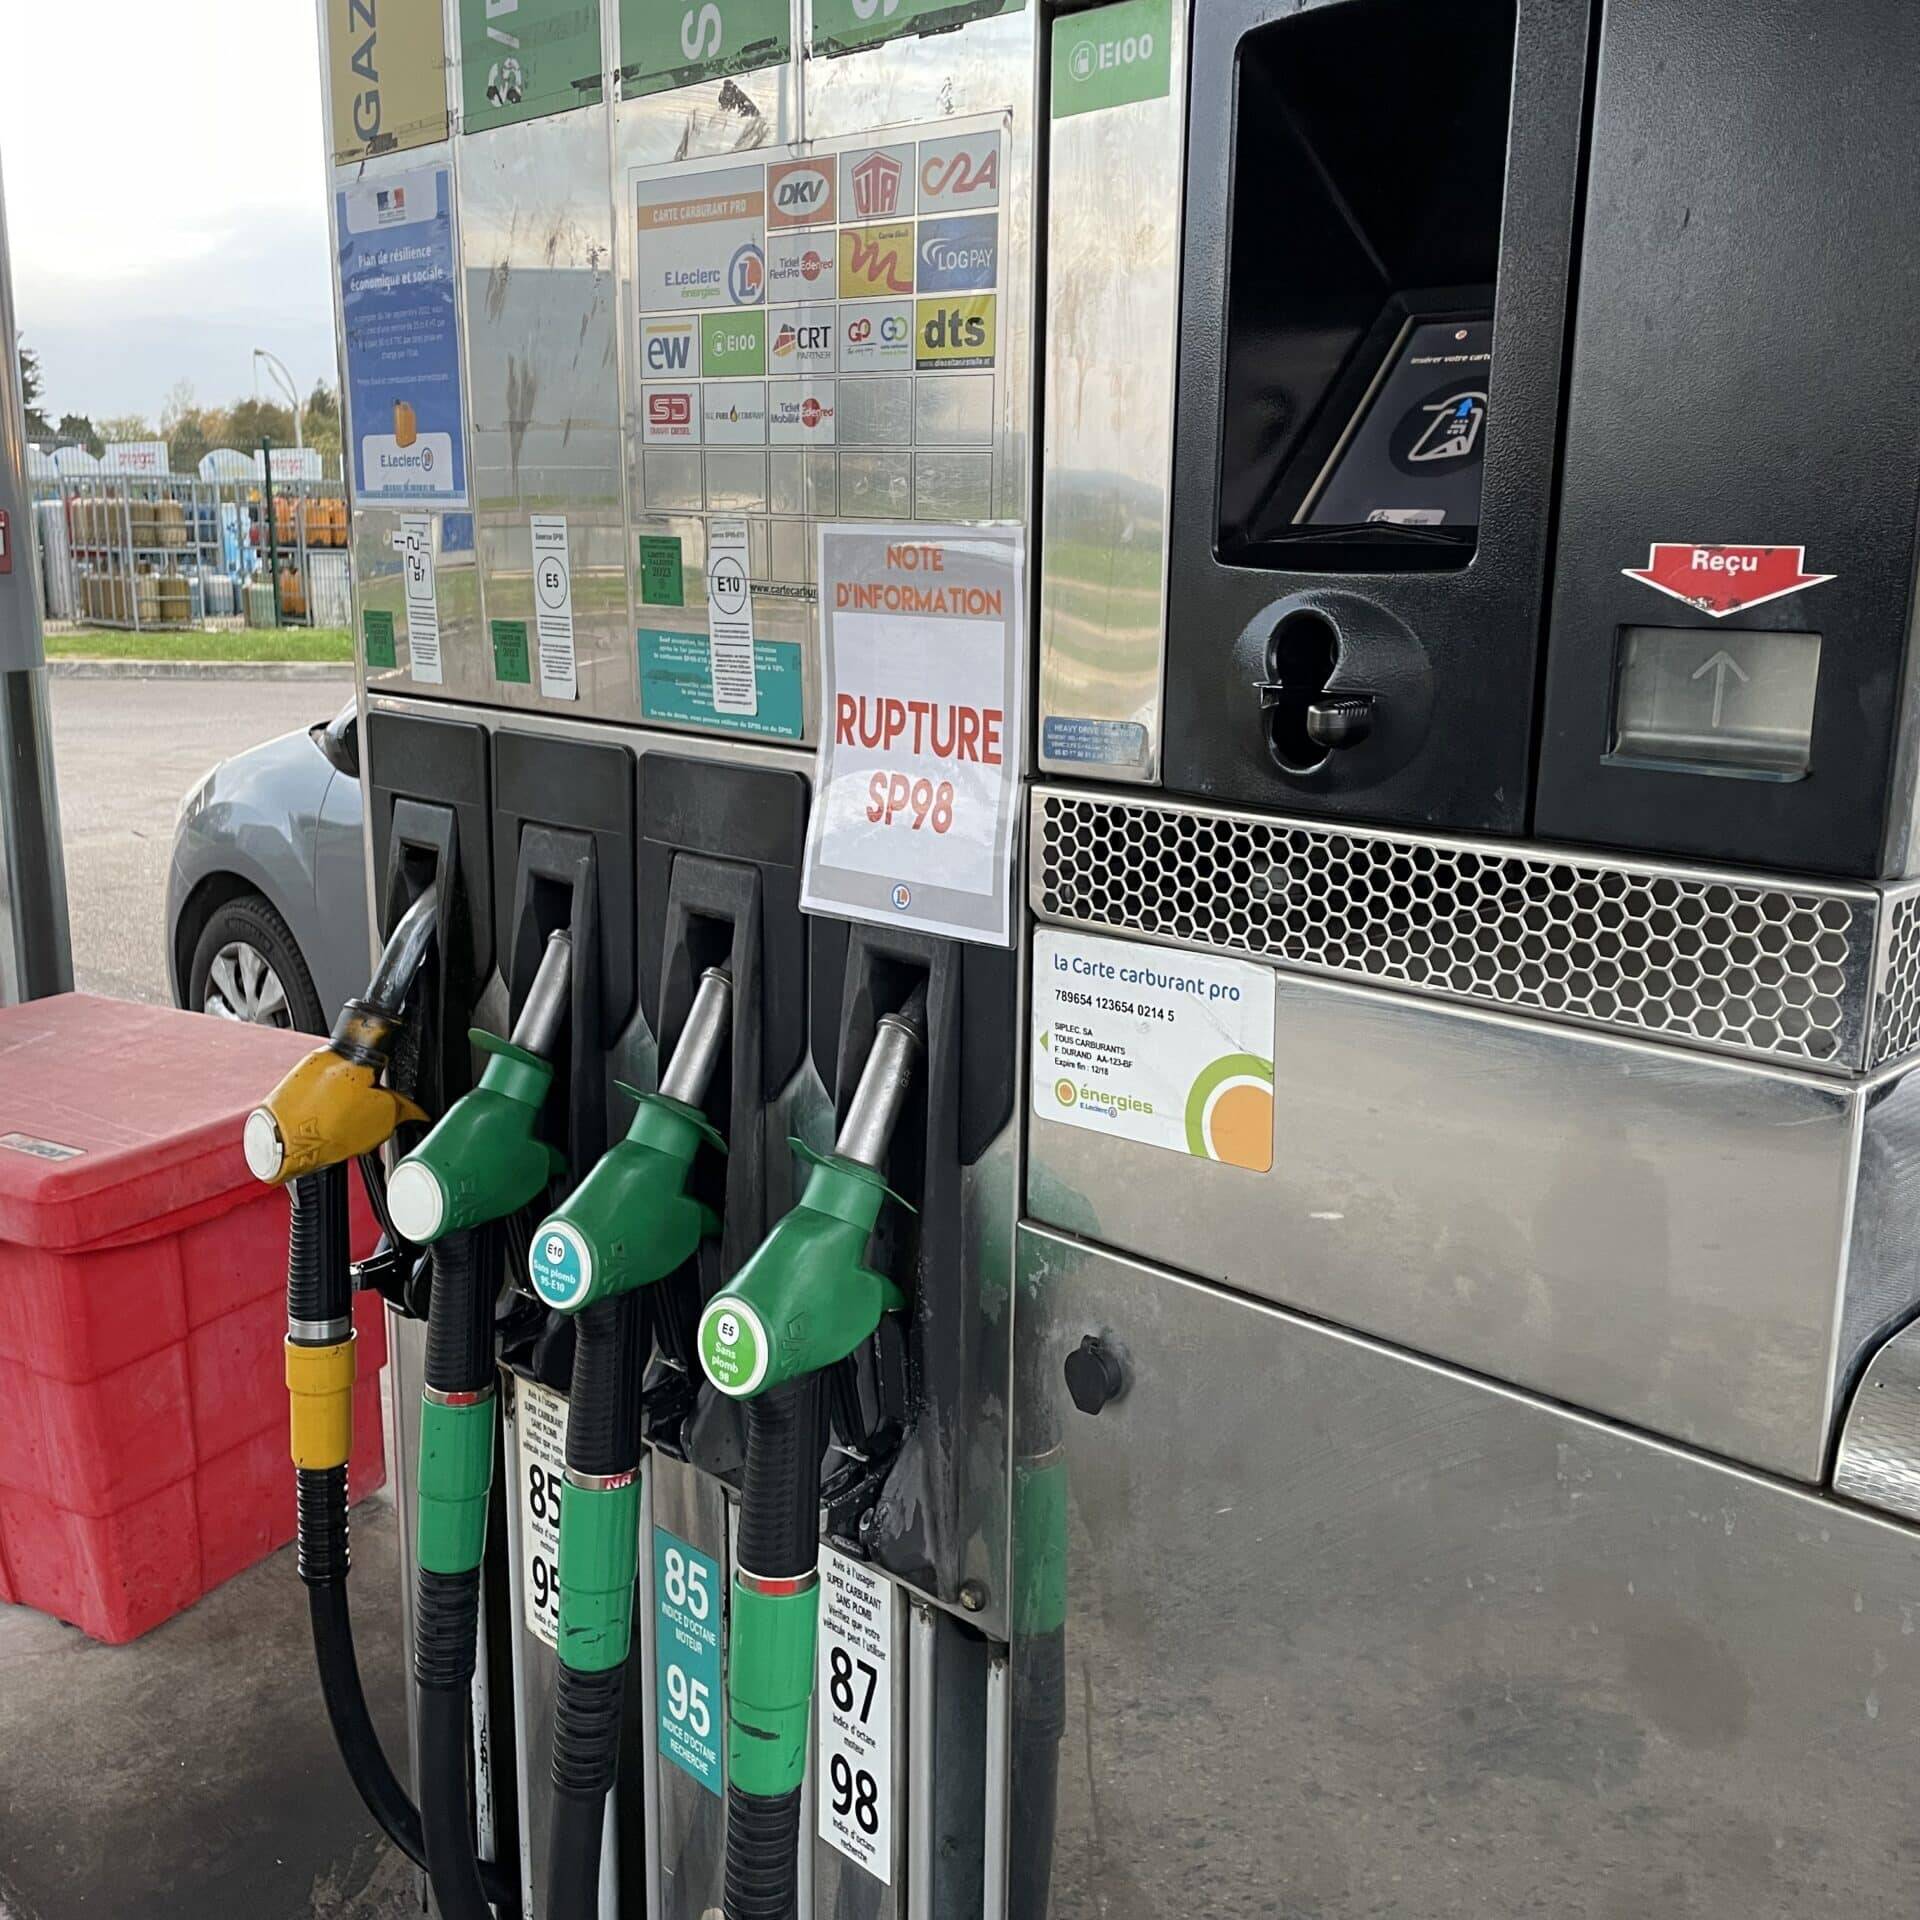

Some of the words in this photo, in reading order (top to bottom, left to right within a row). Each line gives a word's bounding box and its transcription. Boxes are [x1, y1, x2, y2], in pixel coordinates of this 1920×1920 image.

[778, 178, 824, 207] DKV
[652, 207, 677, 223] CARTE
[680, 201, 729, 220] CARBURANT
[729, 199, 747, 214] PRO
[358, 254, 377, 268] Plan
[378, 251, 388, 264] de
[390, 245, 432, 263] résilience
[779, 257, 799, 269] Ticket
[800, 257, 833, 272] Edenred
[350, 273, 399, 292] économique
[401, 272, 411, 285] et
[412, 266, 444, 283] sociale
[664, 268, 721, 287] E.Leclerc
[769, 268, 786, 280] Fleet
[786, 268, 799, 279] Pro
[796, 326, 832, 349] CRT
[925, 308, 985, 348] dts
[647, 336, 690, 370] ew
[381, 454, 421, 468] E.Leclerc
[886, 544, 944, 573] NOTE
[1691, 550, 1758, 577] Reçu
[546, 573, 559, 588] E5
[718, 576, 740, 592] E10
[836, 583, 1002, 616] D'INFORMATION
[835, 692, 1004, 766] RUPTURE
[865, 771, 953, 835] SP98
[1054, 953, 1068, 971] la
[1072, 957, 1115, 980] Carte
[1120, 967, 1205, 995] carburant
[1209, 982, 1241, 1001] pro
[1055, 989, 1092, 1007] 789654
[1095, 996, 1134, 1015] 123654
[1137, 1003, 1165, 1020] 0214
[1167, 1009, 1175, 1022] 5
[1055, 1033, 1074, 1044] TOUS
[1075, 1038, 1126, 1055] CARBURANTS
[1083, 1027, 1093, 1036] SA
[1061, 1047, 1092, 1060] DURAND
[1077, 1061, 1086, 1071] fin
[1091, 1065, 1109, 1076] 12/18
[1080, 1083, 1153, 1114] énergies
[548, 1243, 563, 1258] E10
[534, 1259, 549, 1275] Sans
[550, 1268, 576, 1285] plomb
[541, 1275, 565, 1293] 95-E10
[722, 1323, 735, 1337] E5
[715, 1342, 736, 1360] Sans
[711, 1354, 739, 1374] plomb
[719, 1370, 730, 1383] 98
[664, 1548, 709, 1620] 85
[832, 1557, 845, 1573] Avis
[846, 1563, 851, 1576] à
[852, 1566, 876, 1589] l'usager
[826, 1571, 844, 1590] SUPER
[845, 1582, 881, 1610] CARBURANT
[835, 1592, 851, 1609] SANS
[852, 1600, 873, 1621] PLOMB
[662, 1601, 683, 1625] INDICE
[684, 1615, 717, 1647] D'OCTANE
[851, 1619, 863, 1632] que
[864, 1625, 881, 1642] votre
[675, 1627, 703, 1656] MOTEUR
[847, 1632, 861, 1647] peut
[830, 1645, 878, 1724] 87
[666, 1663, 710, 1737] 95
[832, 1713, 849, 1731] Indice
[662, 1715, 684, 1741] INDICE
[684, 1731, 717, 1765] D'OCTANE
[843, 1736, 866, 1757] moteur
[670, 1737, 709, 1776] RECHERCHE
[830, 1752, 879, 1835] 98
[832, 1815, 849, 1836] Indice
[840, 1837, 869, 1864] recherche
